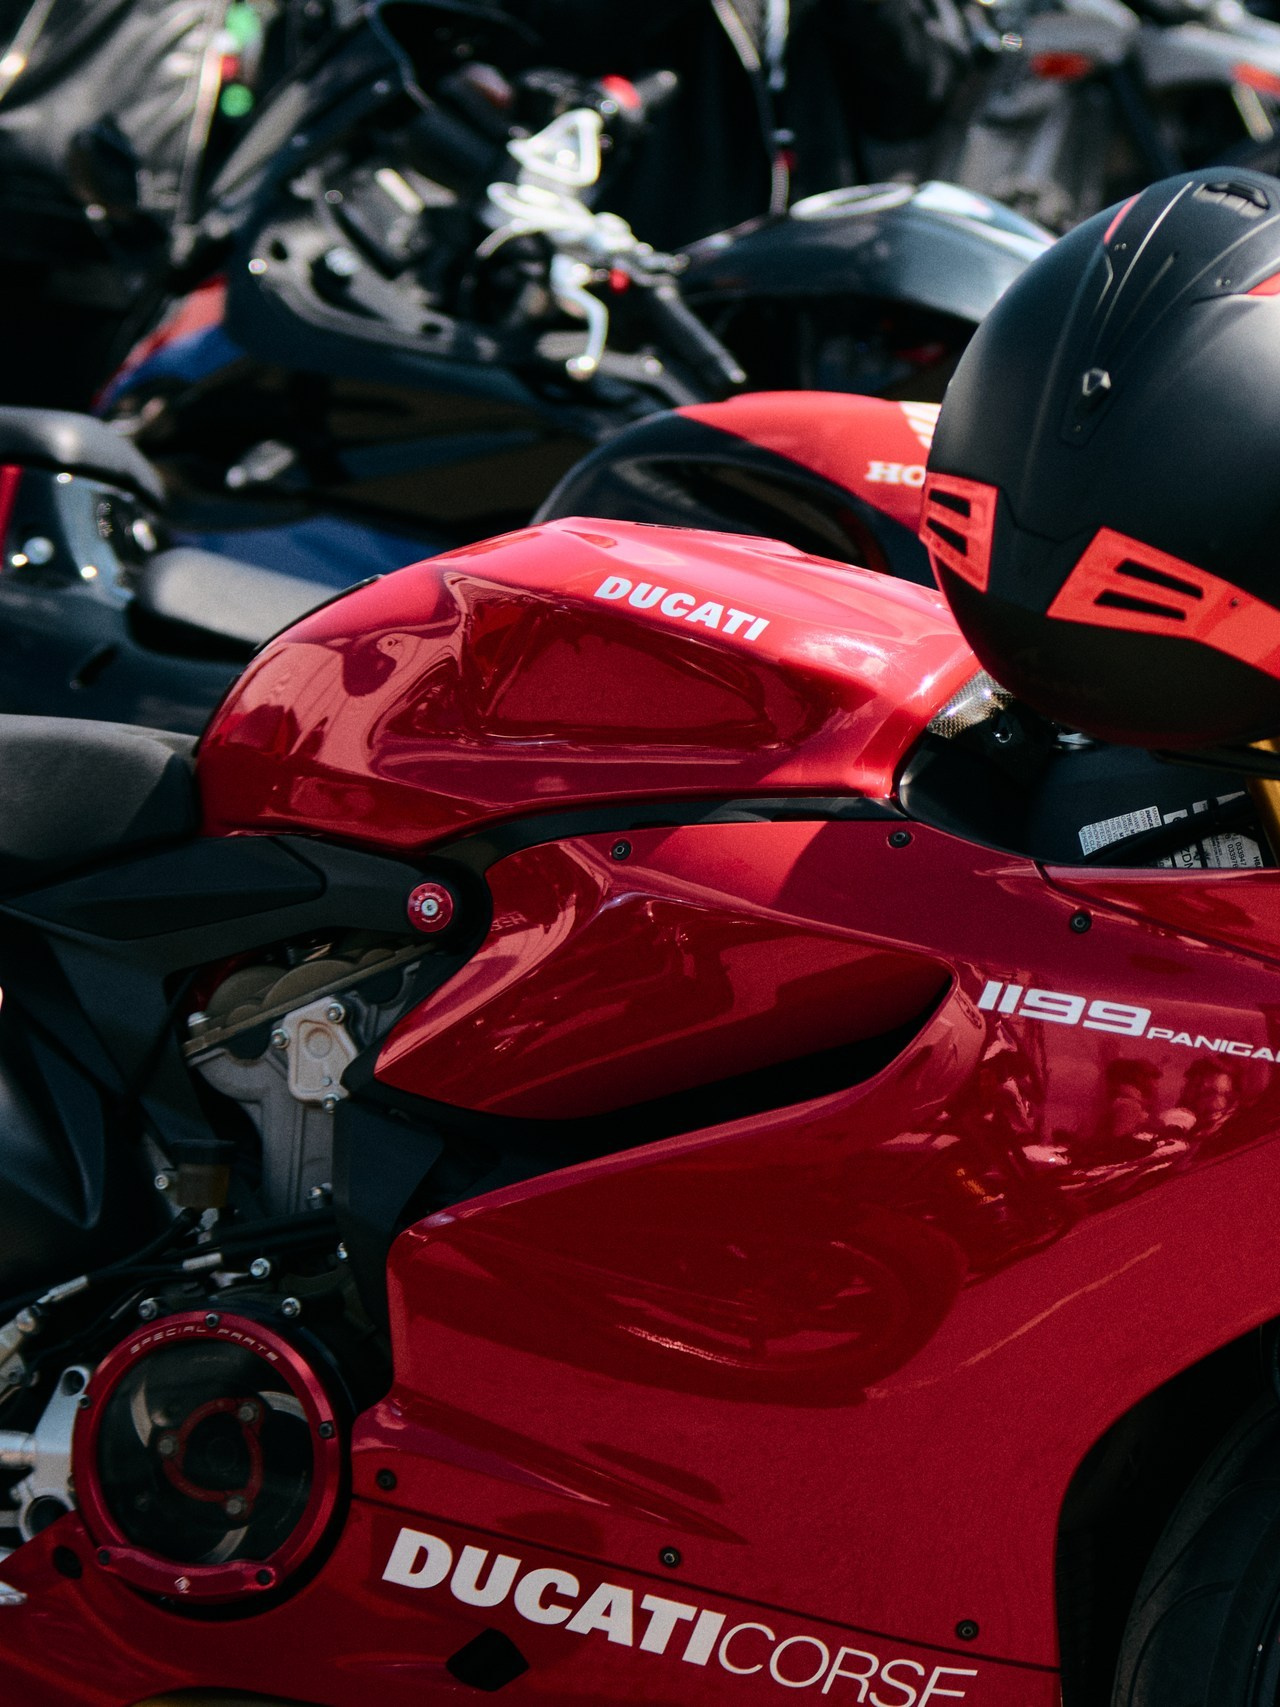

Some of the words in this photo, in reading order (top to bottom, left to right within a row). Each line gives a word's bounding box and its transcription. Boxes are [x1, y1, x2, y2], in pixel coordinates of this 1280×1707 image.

[593, 575, 770, 641] DUCATI
[1145, 809, 1154, 828] DUCA
[977, 980, 1152, 1037] 1199
[130, 1325, 207, 1354] SPECIAL
[217, 1328, 279, 1362] PARTS
[382, 1527, 726, 1666] DUCATI
